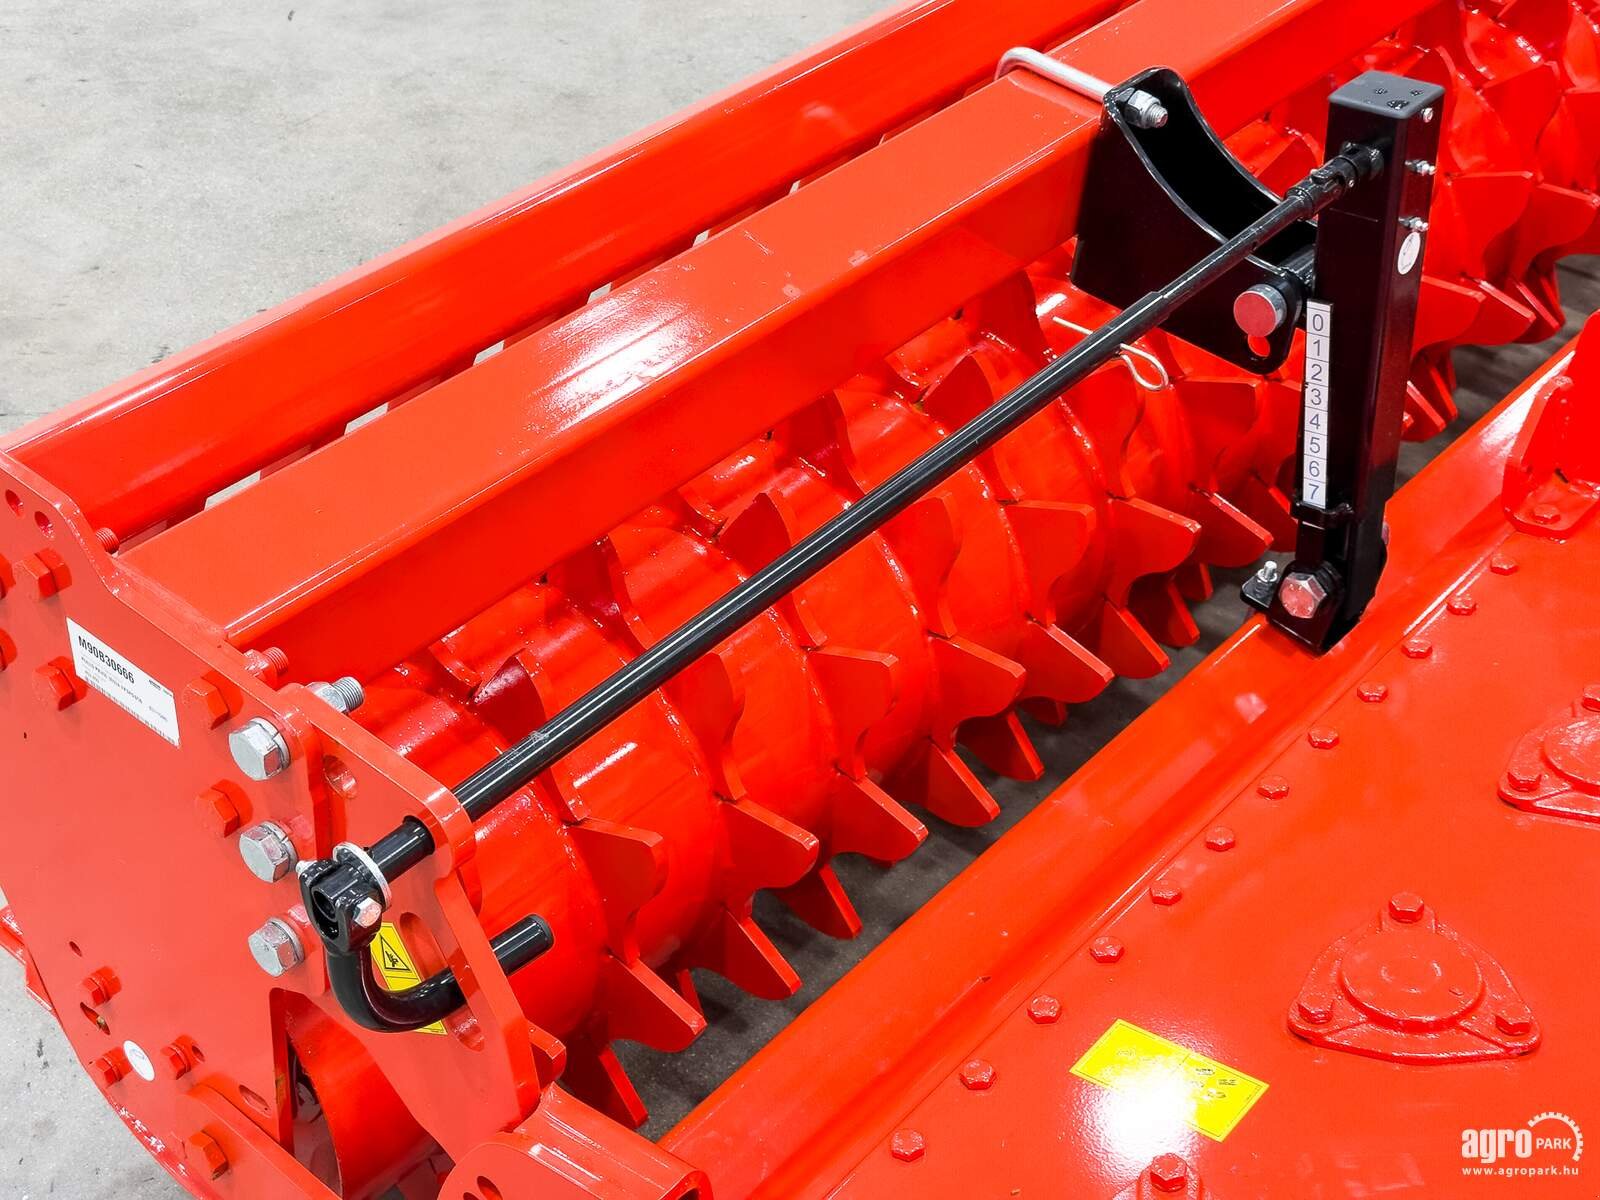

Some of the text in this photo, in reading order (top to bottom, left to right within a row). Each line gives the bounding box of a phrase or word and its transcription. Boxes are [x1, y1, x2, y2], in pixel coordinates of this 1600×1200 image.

[1312, 313, 1324, 332] 0
[1313, 339, 1321, 357] 1
[1311, 363, 1323, 382] 2
[1310, 388, 1322, 406] 3
[1309, 413, 1321, 430] 4
[1309, 436, 1321, 454] 5
[1308, 460, 1320, 478] 6
[1308, 483, 1320, 500] 7
